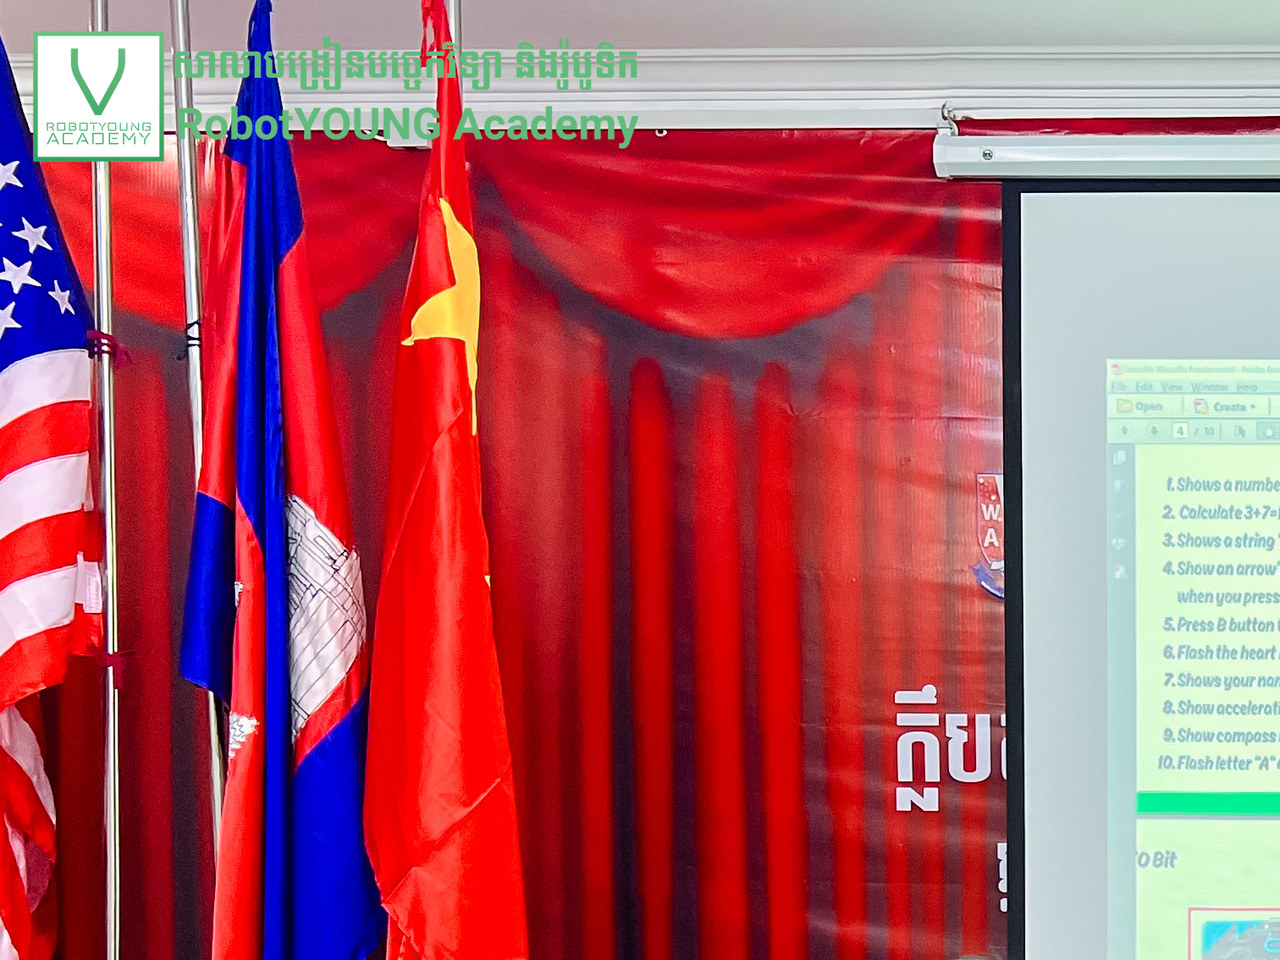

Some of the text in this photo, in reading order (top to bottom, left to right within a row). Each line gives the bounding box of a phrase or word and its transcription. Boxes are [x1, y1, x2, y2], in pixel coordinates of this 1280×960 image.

[1135, 402, 1246, 412] Open Create
[1176, 426, 1184, 436] 4
[1204, 427, 1214, 436] 10
[1177, 477, 1221, 492] Shows
[1224, 481, 1232, 492] a
[981, 503, 1000, 520] W
[1162, 505, 1175, 519] 2.
[1179, 505, 1243, 519] Calculate
[984, 528, 999, 547] A
[1162, 533, 1175, 548] 3.
[1177, 533, 1221, 548] Shows
[1224, 537, 1232, 548] a
[1234, 531, 1275, 551] string
[1163, 617, 1175, 632] 5.
[1177, 618, 1214, 632] Press
[1217, 618, 1227, 632] B
[1229, 618, 1274, 632] button
[1164, 673, 1176, 687] 7.
[1177, 673, 1221, 687] Shows
[1224, 676, 1255, 691] your
[1163, 701, 1176, 715] 8.
[1177, 701, 1214, 715] Show
[1152, 850, 1177, 868] Bit
